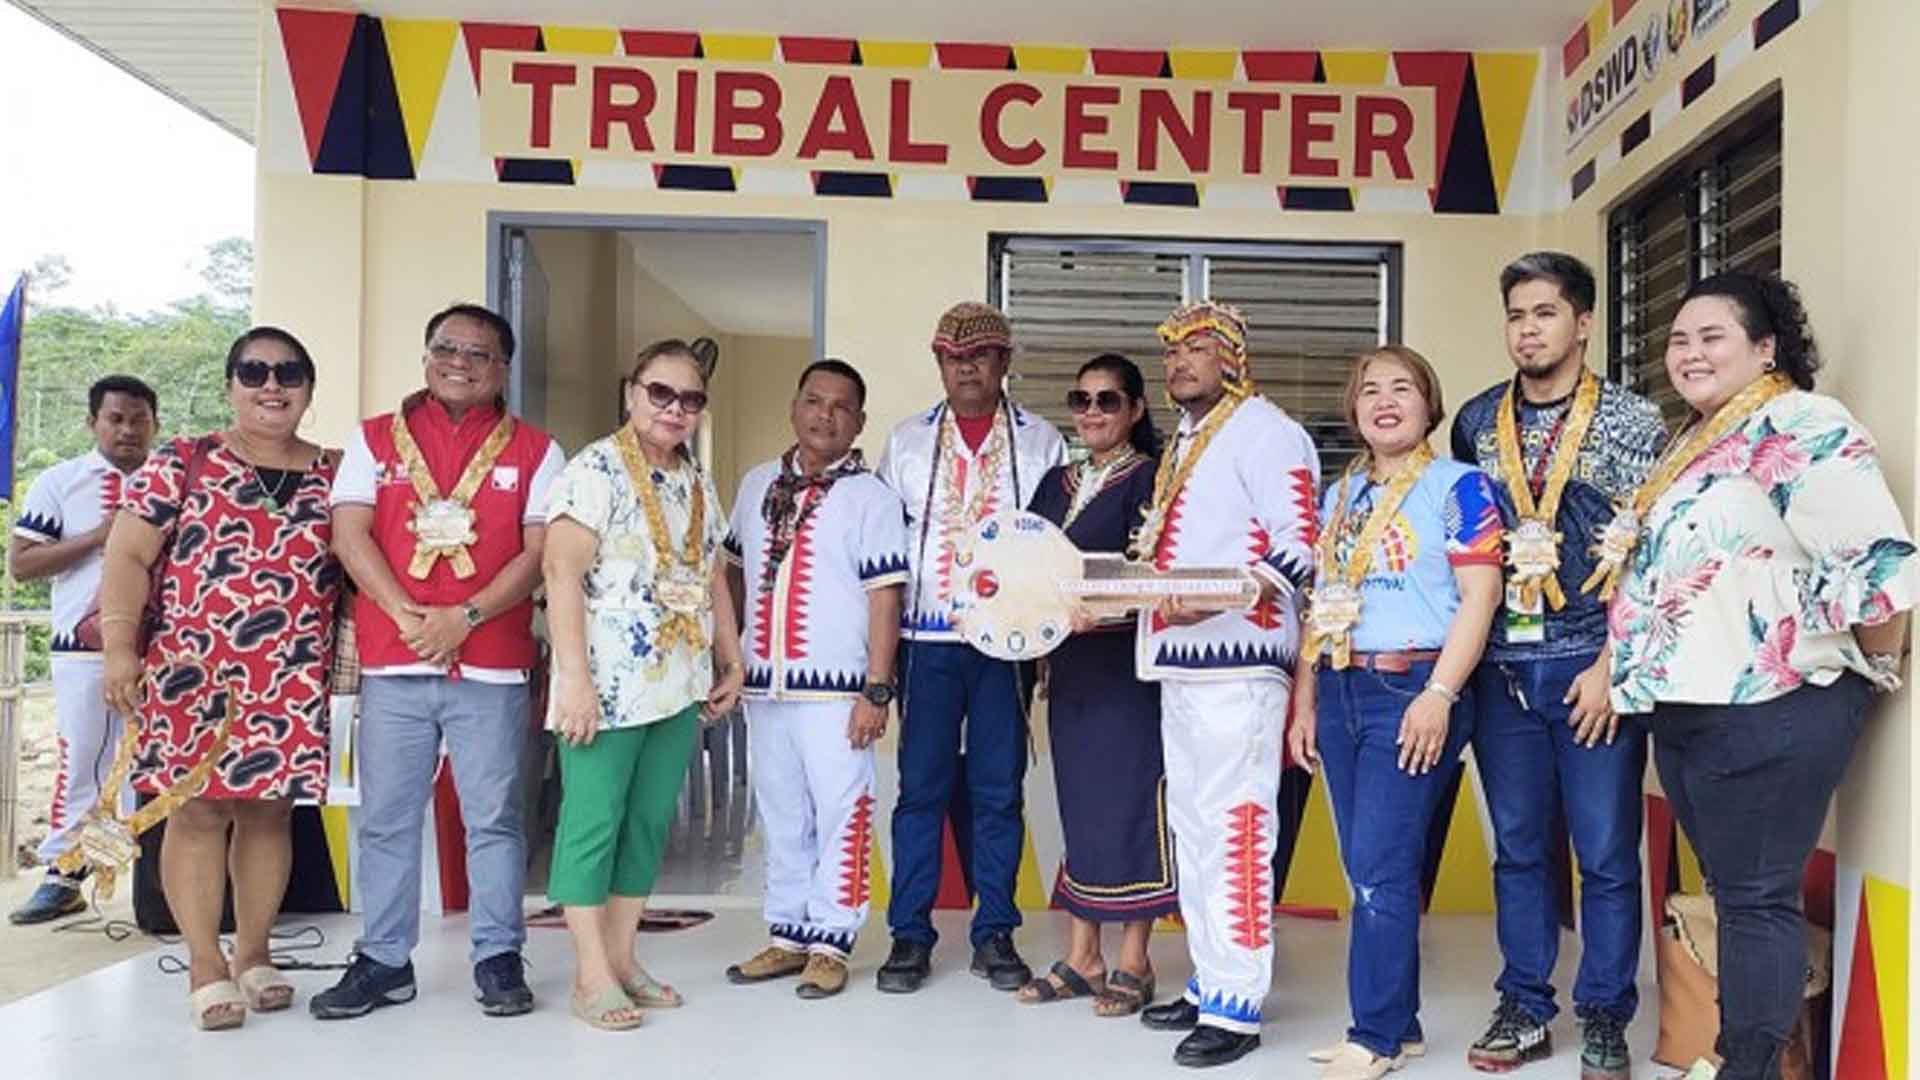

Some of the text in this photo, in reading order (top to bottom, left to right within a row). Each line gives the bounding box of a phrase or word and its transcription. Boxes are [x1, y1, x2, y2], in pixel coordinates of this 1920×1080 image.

[512, 62, 1415, 179] TRIBAL CENTER
[1580, 35, 1638, 127] DSWD
